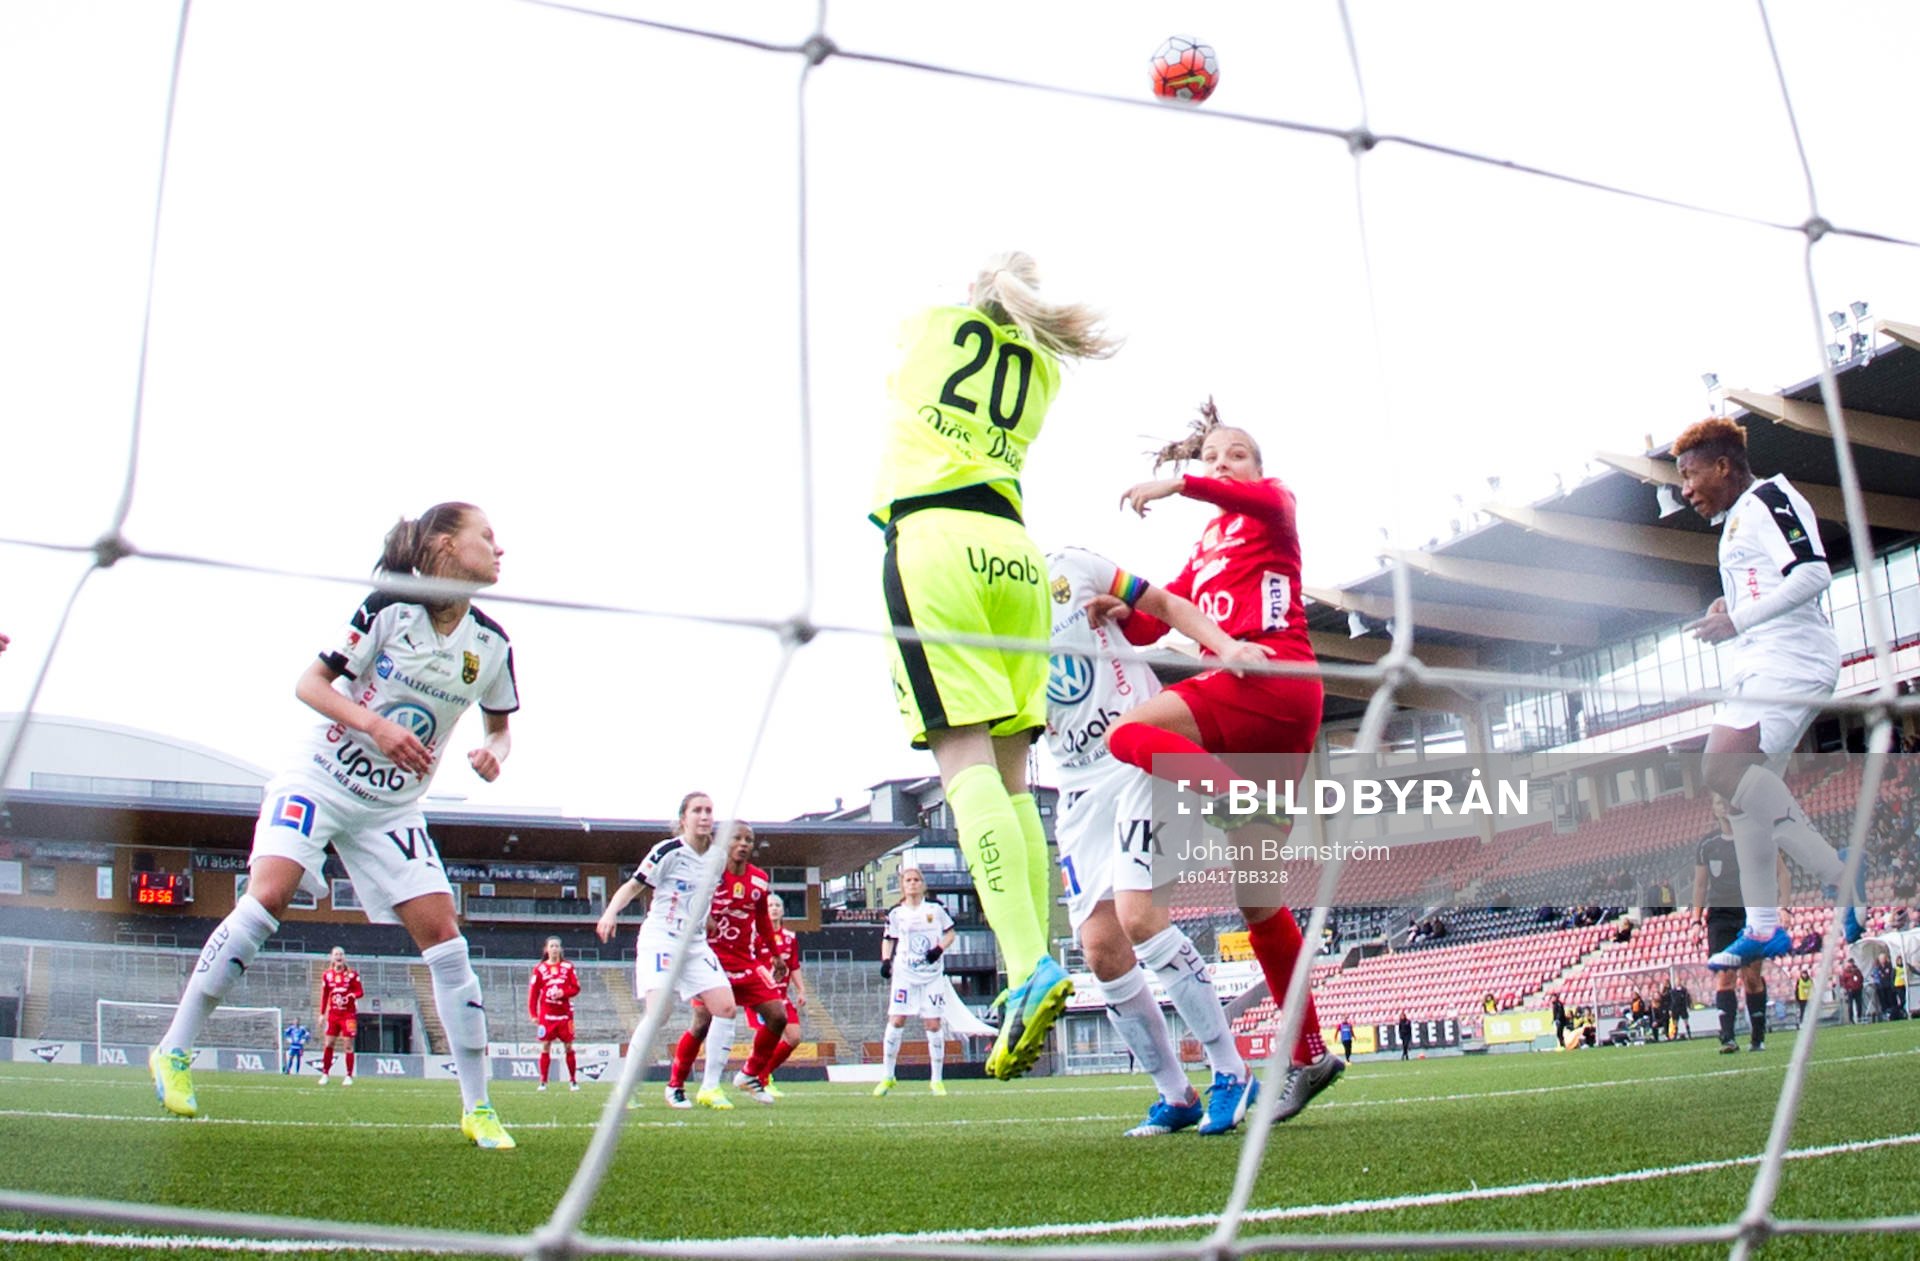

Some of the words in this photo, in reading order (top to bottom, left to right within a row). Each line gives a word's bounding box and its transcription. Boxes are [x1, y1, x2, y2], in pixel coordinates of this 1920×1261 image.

[939, 319, 1034, 431] 20
[966, 546, 1040, 585] Upab
[336, 740, 405, 792] Upab
[1117, 819, 1168, 857] VK
[979, 829, 1006, 893] ATEA
[101, 1049, 129, 1065] NA
[236, 1054, 265, 1071] NA
[376, 1058, 405, 1074] NA
[511, 1061, 540, 1078] NA
